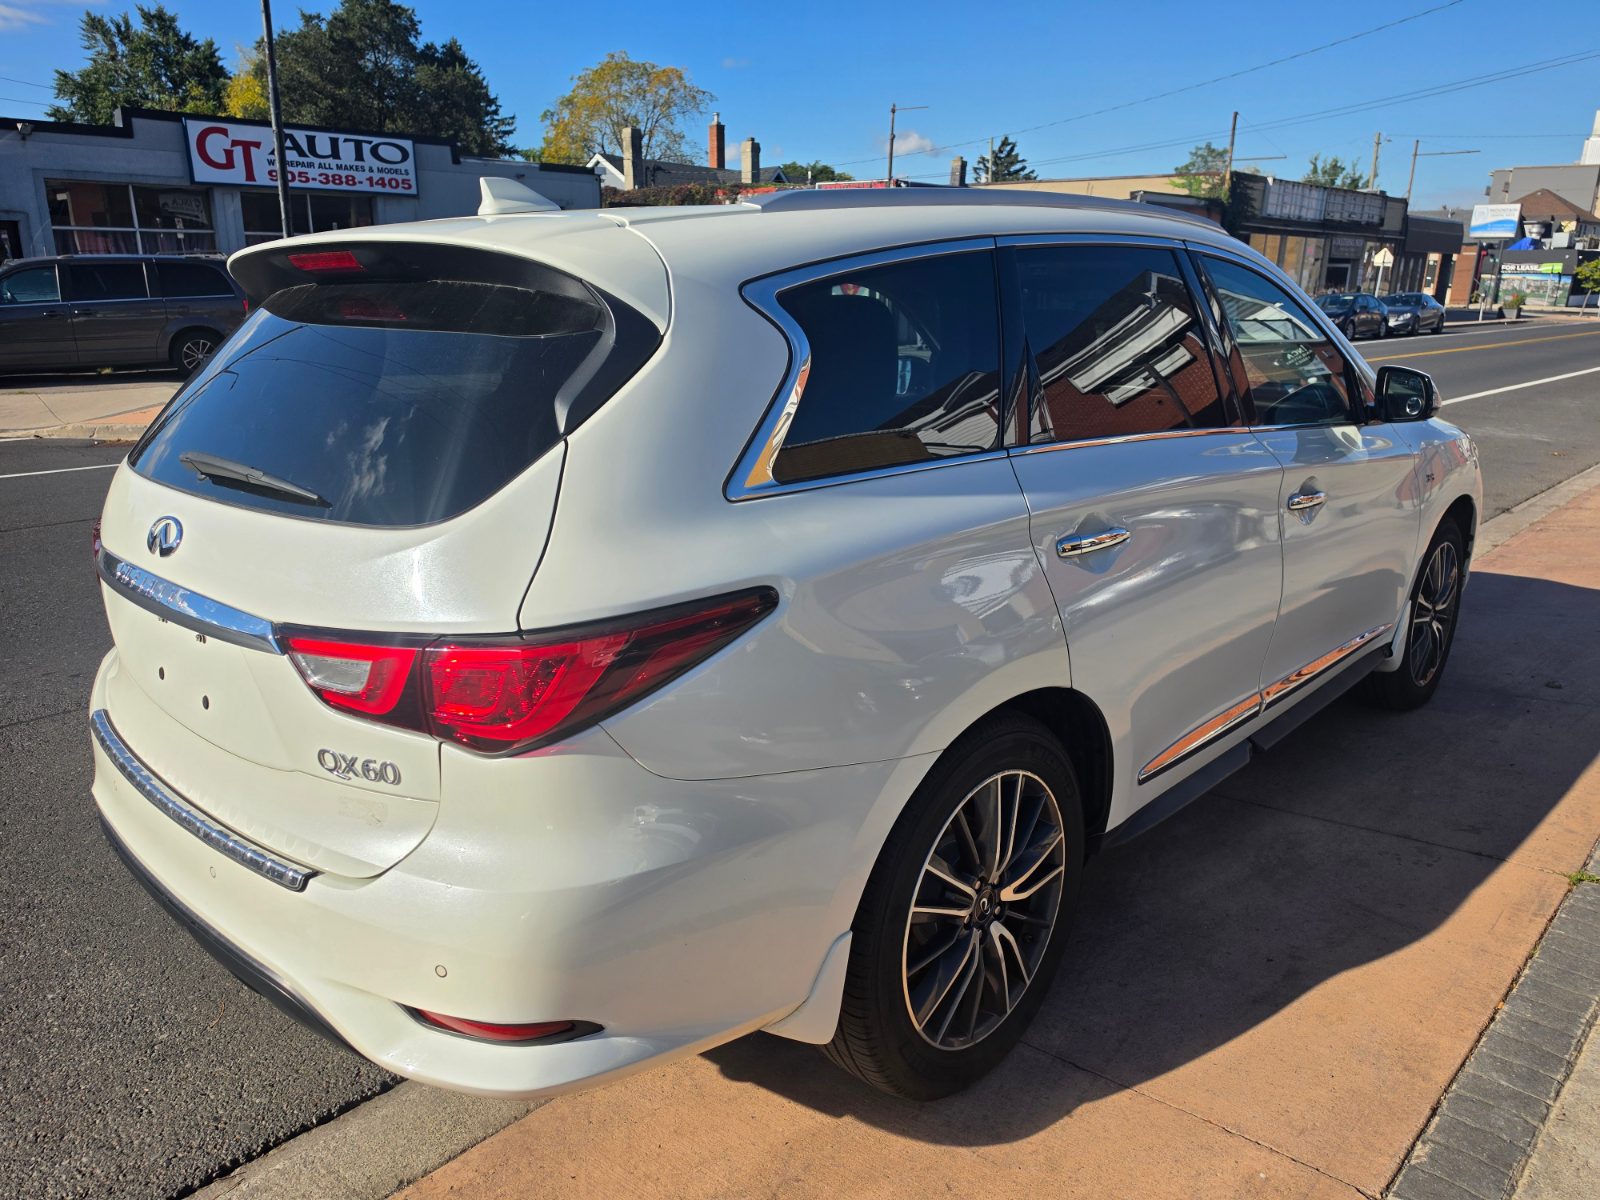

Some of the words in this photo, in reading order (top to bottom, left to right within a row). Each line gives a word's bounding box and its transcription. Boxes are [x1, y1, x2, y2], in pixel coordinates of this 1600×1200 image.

[196, 126, 262, 182] GT
[268, 133, 410, 165] AUTO
[285, 160, 316, 170] REPAIR
[318, 162, 334, 170] ALL
[336, 163, 366, 173] MAKES
[377, 167, 410, 176] MODELS
[267, 169, 413, 190] 905-388-1405
[317, 748, 402, 785] QX60
